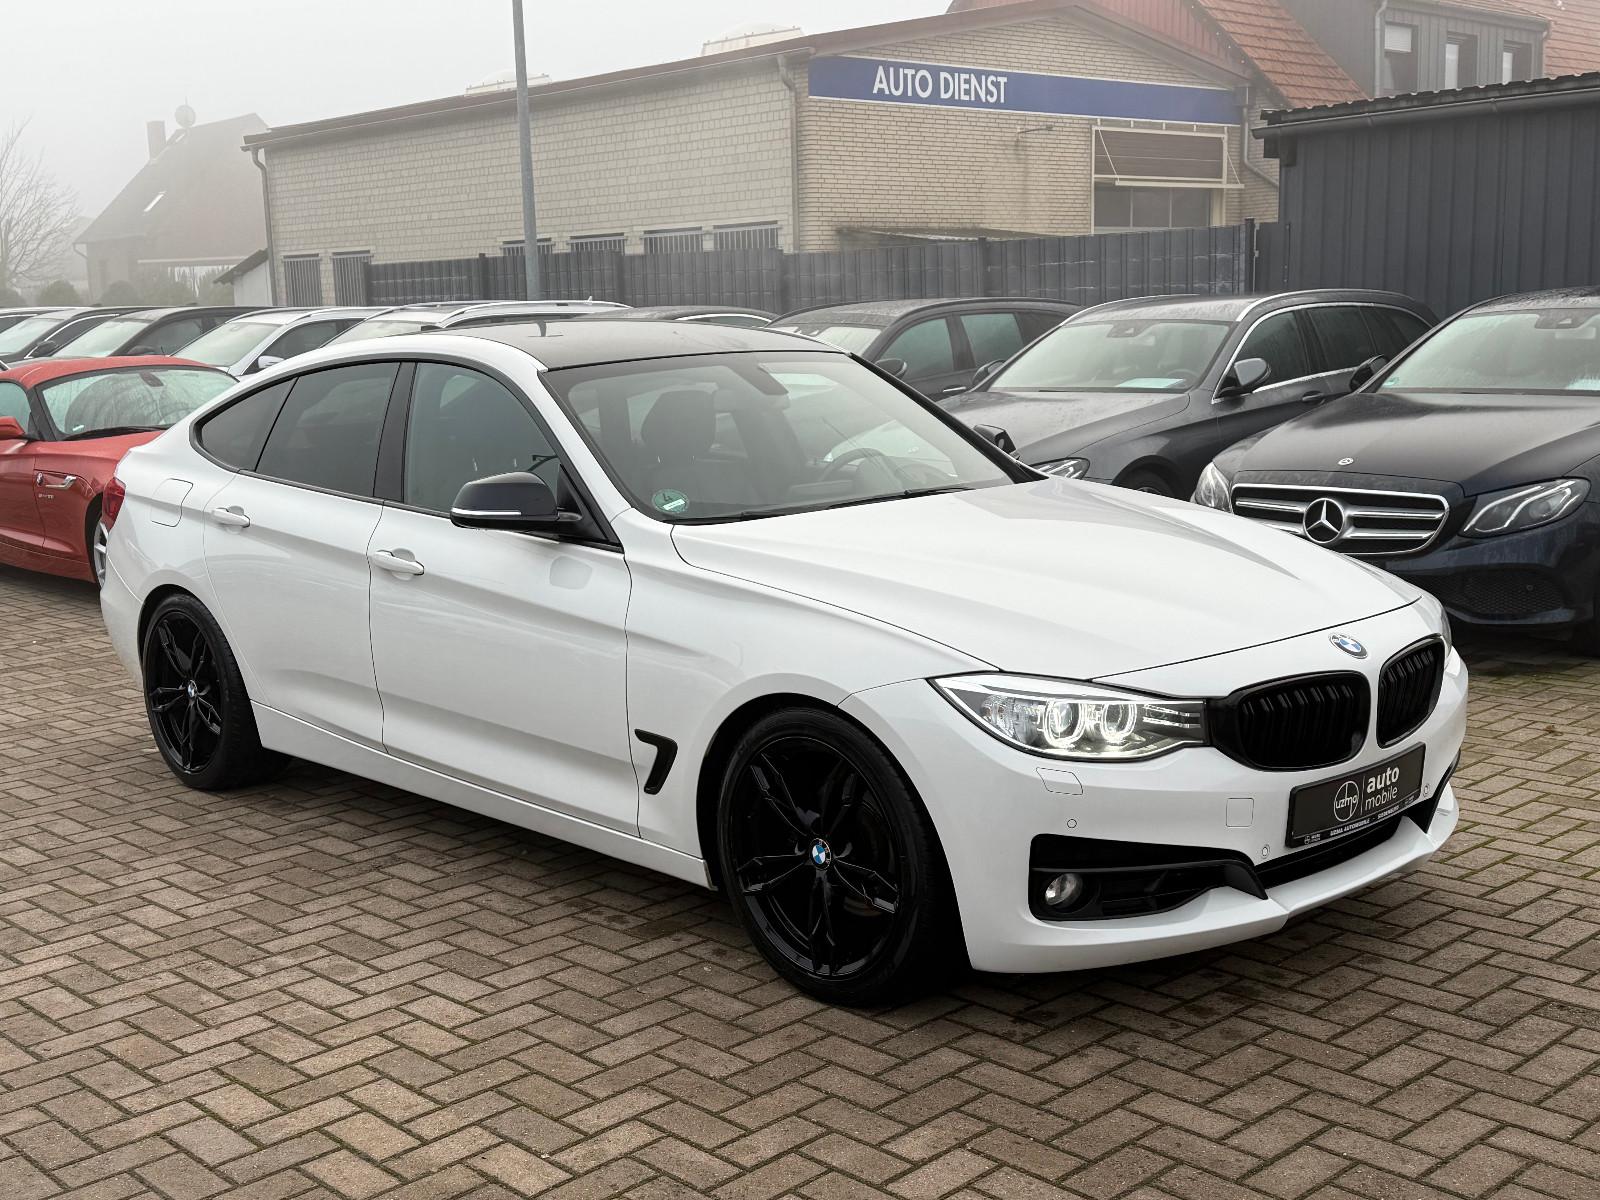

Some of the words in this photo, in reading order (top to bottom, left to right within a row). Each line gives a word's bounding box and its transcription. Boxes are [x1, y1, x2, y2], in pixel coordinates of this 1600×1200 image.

[872, 65, 933, 98] AUTO
[940, 71, 1008, 104] DIENST
[1366, 767, 1400, 793] auto
[1364, 786, 1398, 810] mobile
